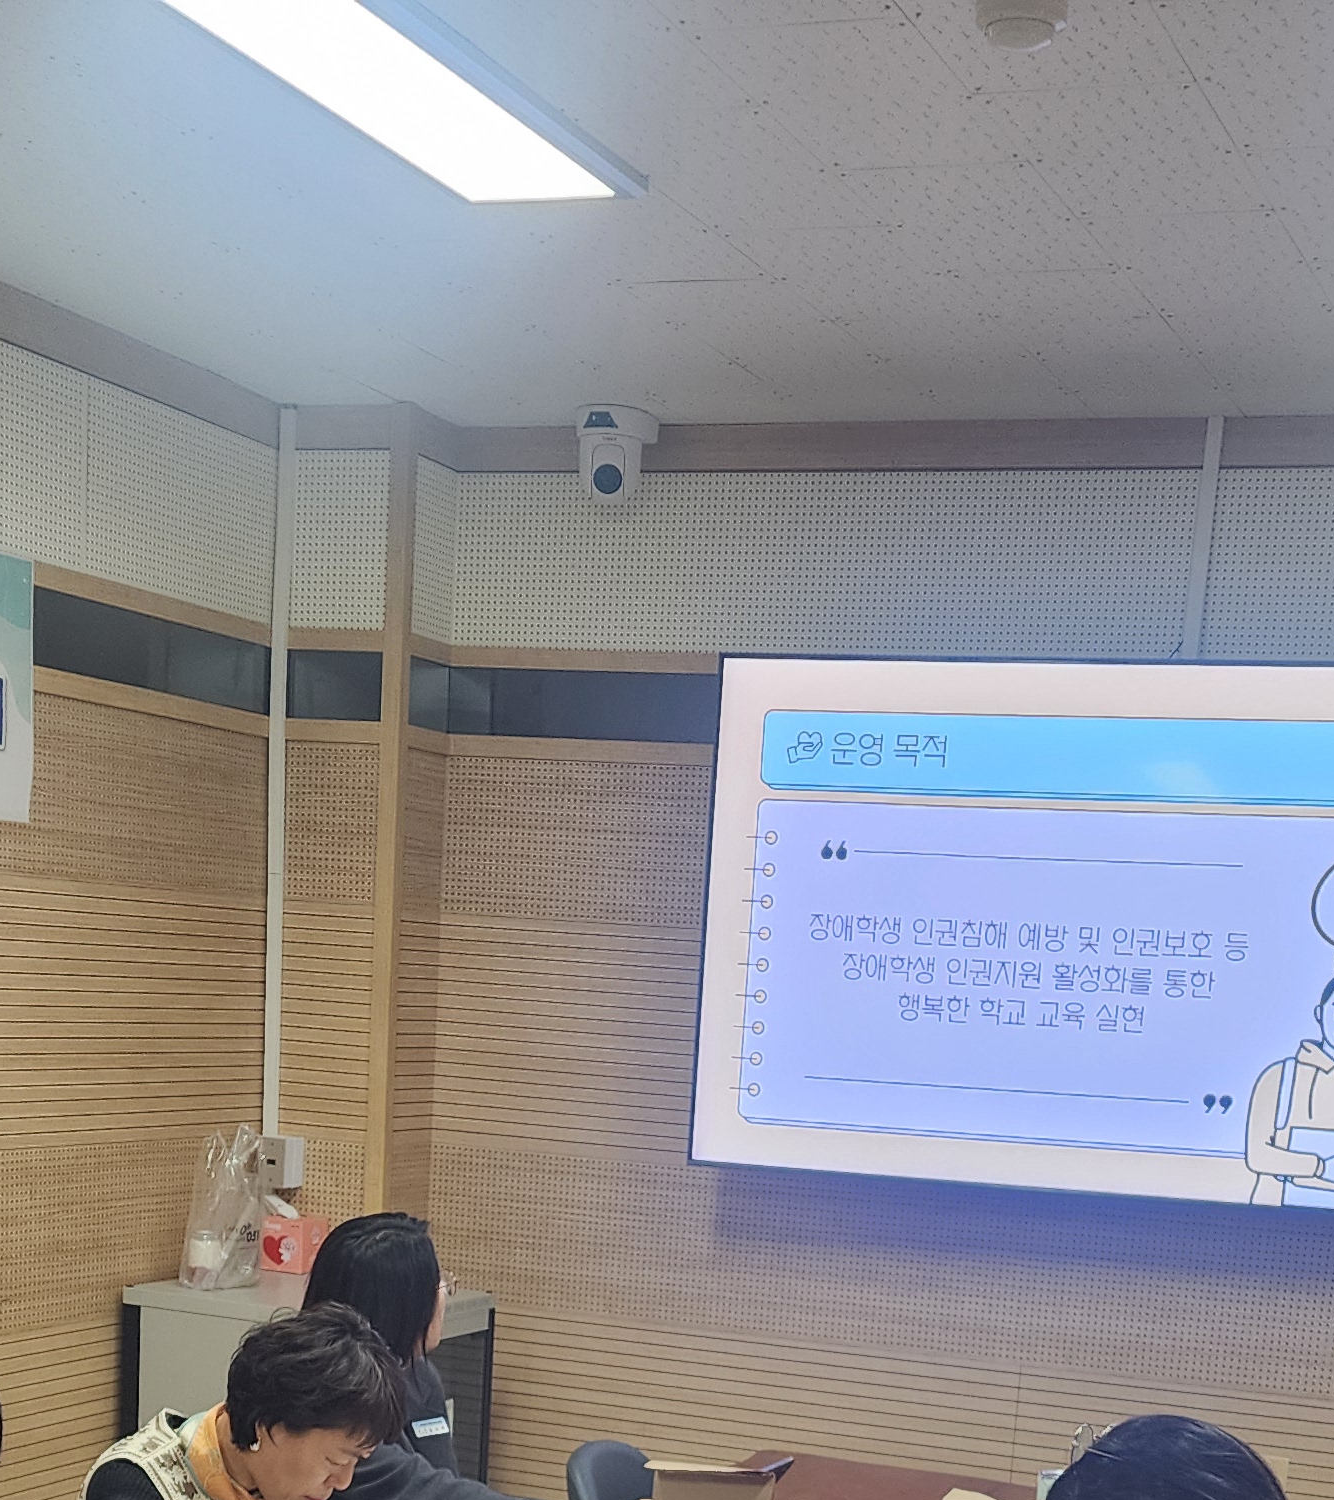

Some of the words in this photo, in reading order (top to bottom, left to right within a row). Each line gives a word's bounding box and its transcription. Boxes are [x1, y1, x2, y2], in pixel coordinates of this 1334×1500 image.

[830, 732, 884, 767] 운영
[893, 734, 948, 768] 목적
[809, 913, 903, 945] 장애학생
[911, 917, 1009, 950] 인권침해
[1017, 920, 1069, 953] 예방
[1078, 924, 1102, 954] 및
[1111, 926, 1214, 959] 인권보호
[1223, 931, 1250, 962] 등
[841, 952, 937, 985] 장애학생
[945, 957, 1042, 990] 인권지원
[1051, 961, 1153, 995] 활성화를
[1162, 968, 1216, 1000] 통한
[897, 992, 969, 1023] 행복한
[979, 996, 1026, 1027] 학교
[1036, 1000, 1085, 1031] 교육
[1095, 1003, 1145, 1034] 실현
